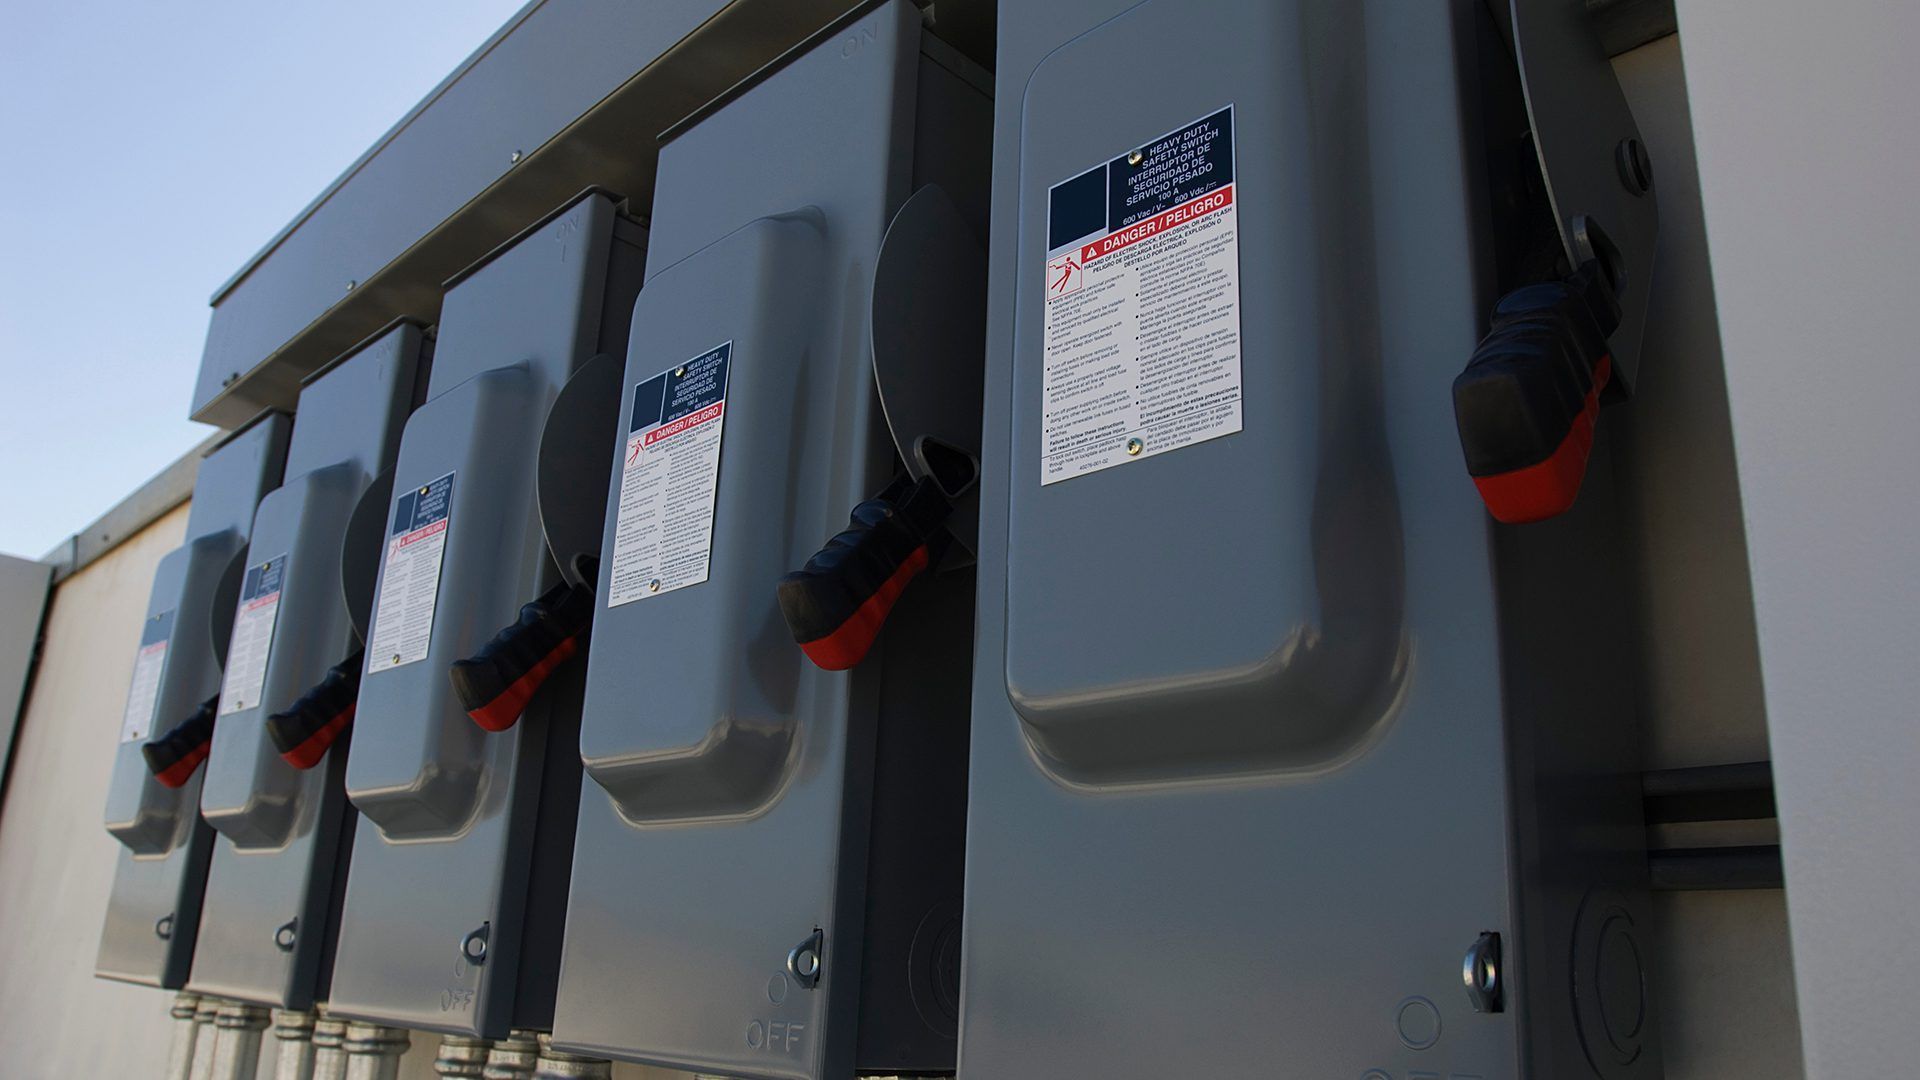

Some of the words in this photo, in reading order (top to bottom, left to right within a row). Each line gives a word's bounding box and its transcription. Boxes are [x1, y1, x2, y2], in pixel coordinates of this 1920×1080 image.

[841, 22, 879, 60] ON
[1142, 146, 1177, 169] SAFETY
[1181, 128, 1218, 152] SWITCH
[1150, 135, 1180, 156] HEAVY
[1184, 122, 1209, 141] DUTY
[1128, 149, 1194, 185] INTERRUPTOR
[1197, 142, 1210, 155] DE
[1133, 161, 1188, 193] SEGURIDAD
[1191, 155, 1204, 168] DE
[1126, 180, 1169, 206] SERVICIO
[1172, 161, 1212, 186] PESADO
[1158, 190, 1170, 201] 100
[1173, 186, 1179, 195] A
[1103, 220, 1154, 251] DANGER
[1158, 217, 1162, 229] /
[1166, 192, 1223, 226] PELIGRO
[1122, 214, 1135, 225] 600
[1137, 207, 1150, 219] Vac
[1174, 192, 1187, 204] 600
[1189, 185, 1203, 197] Vdc
[1113, 244, 1137, 258] ELECTRIC
[1200, 214, 1212, 223] ARC
[1213, 207, 1231, 218] FLASH
[1124, 253, 1150, 267] DESTELLO
[1151, 248, 1162, 257] POR
[1164, 239, 1186, 252] ARQUEO
[1124, 246, 1151, 261] DESCARGA
[683, 366, 702, 380] SAFETY
[702, 357, 722, 371] SWITCH
[687, 358, 703, 371] HEAVY
[704, 351, 719, 363] DUTY
[671, 391, 693, 406] SERVICIO
[694, 382, 716, 396] PESADO
[674, 370, 708, 391] INTERRUPTOR
[676, 379, 705, 397] SEGURIDAD
[656, 420, 683, 439] DANGER
[688, 406, 718, 426] PELIGRO
[440, 988, 473, 1012] OFF
[745, 1018, 805, 1053] OFF
